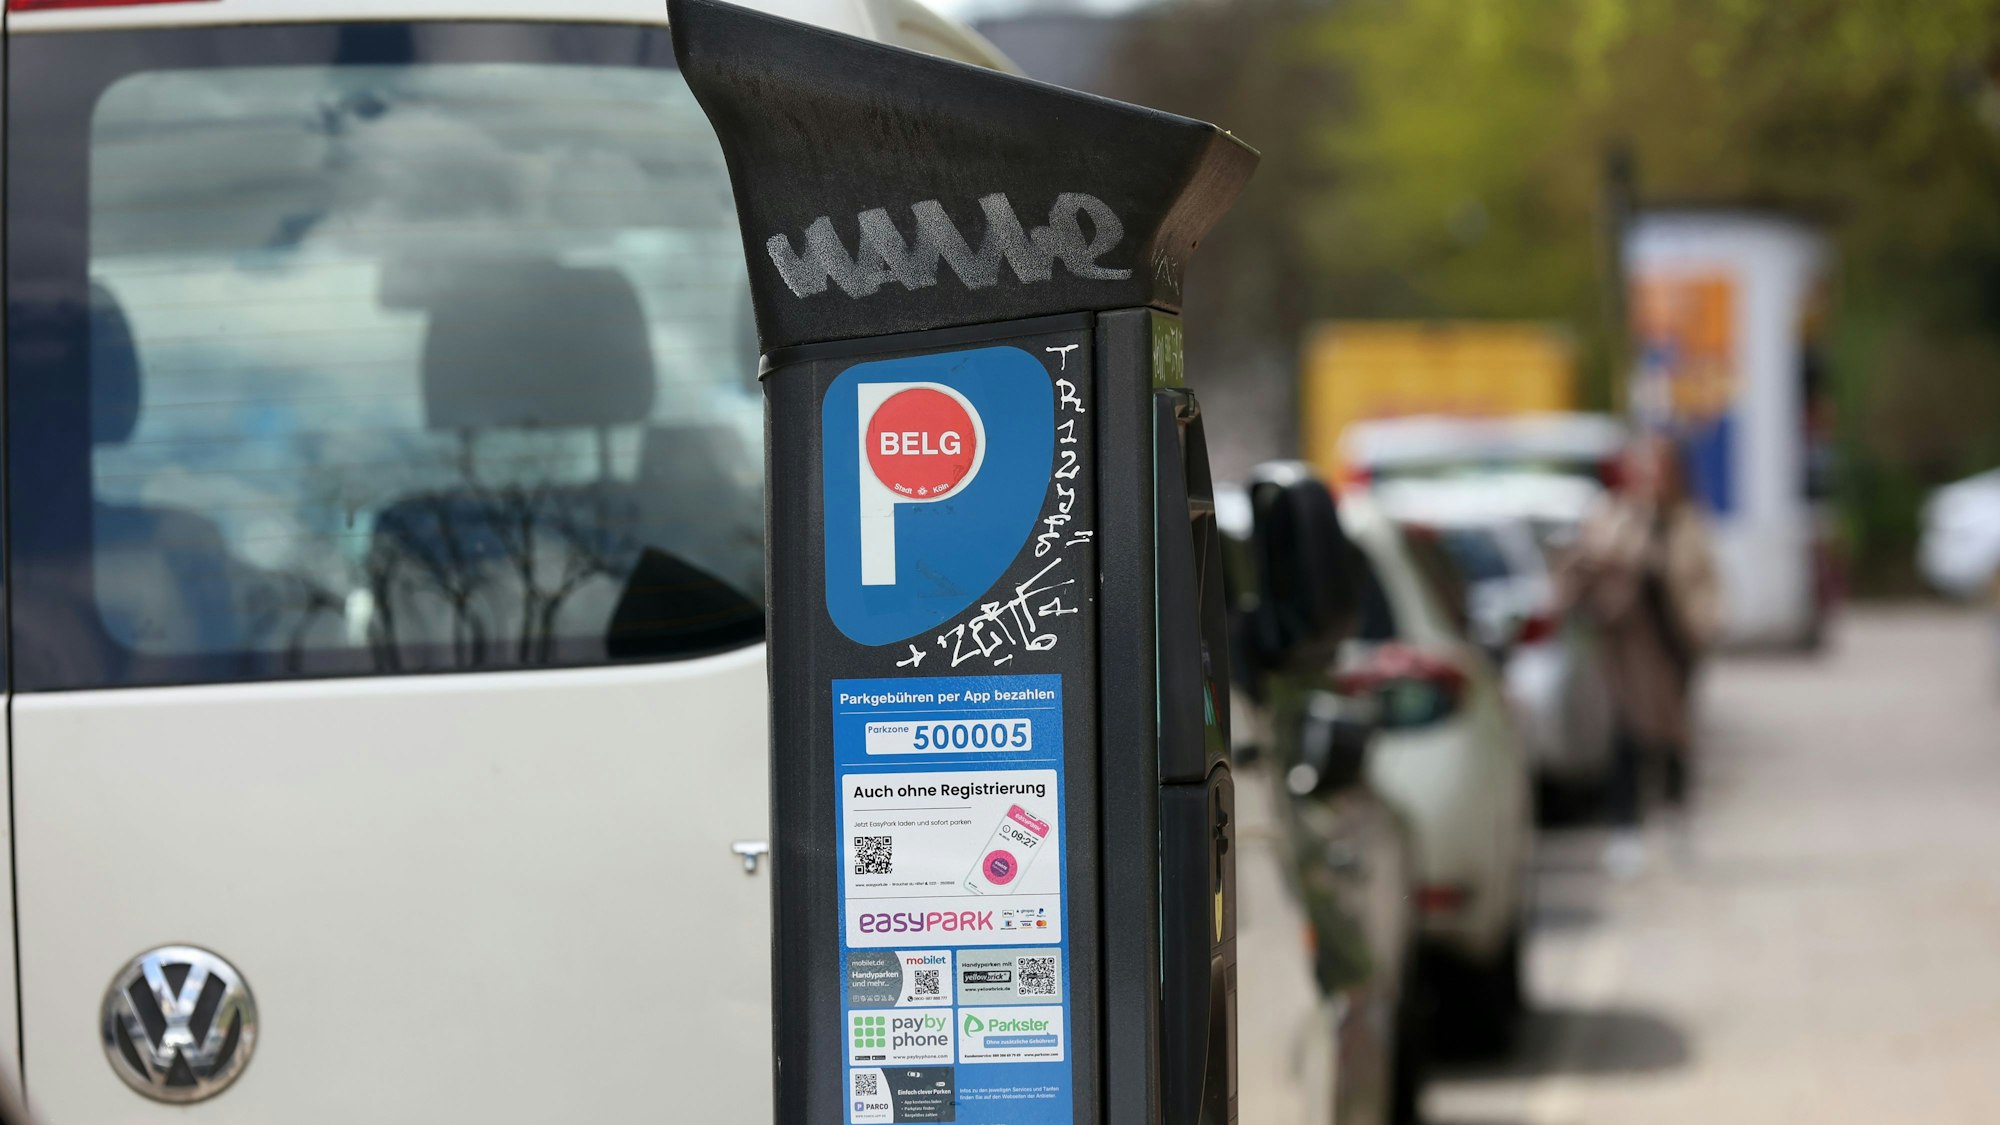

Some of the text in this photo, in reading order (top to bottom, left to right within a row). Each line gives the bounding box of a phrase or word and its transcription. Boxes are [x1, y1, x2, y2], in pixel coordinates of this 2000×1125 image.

[880, 431, 961, 456] BELG
[894, 482, 950, 495] Stadt Köln
[840, 689, 1055, 707] Parkgebühren per App bezahlen
[868, 723, 1028, 750] Parkzone 500005
[853, 782, 1046, 799] Auch ohne Registrierung
[950, 819, 972, 827] parken
[1011, 830, 1037, 848] 09:27
[906, 955, 946, 965] mobilet
[852, 970, 899, 980] Handyparken
[964, 973, 1003, 982] yellowbrick
[892, 1013, 946, 1032] payby
[988, 1018, 1049, 1032] Parkster
[893, 1032, 948, 1050] phone
